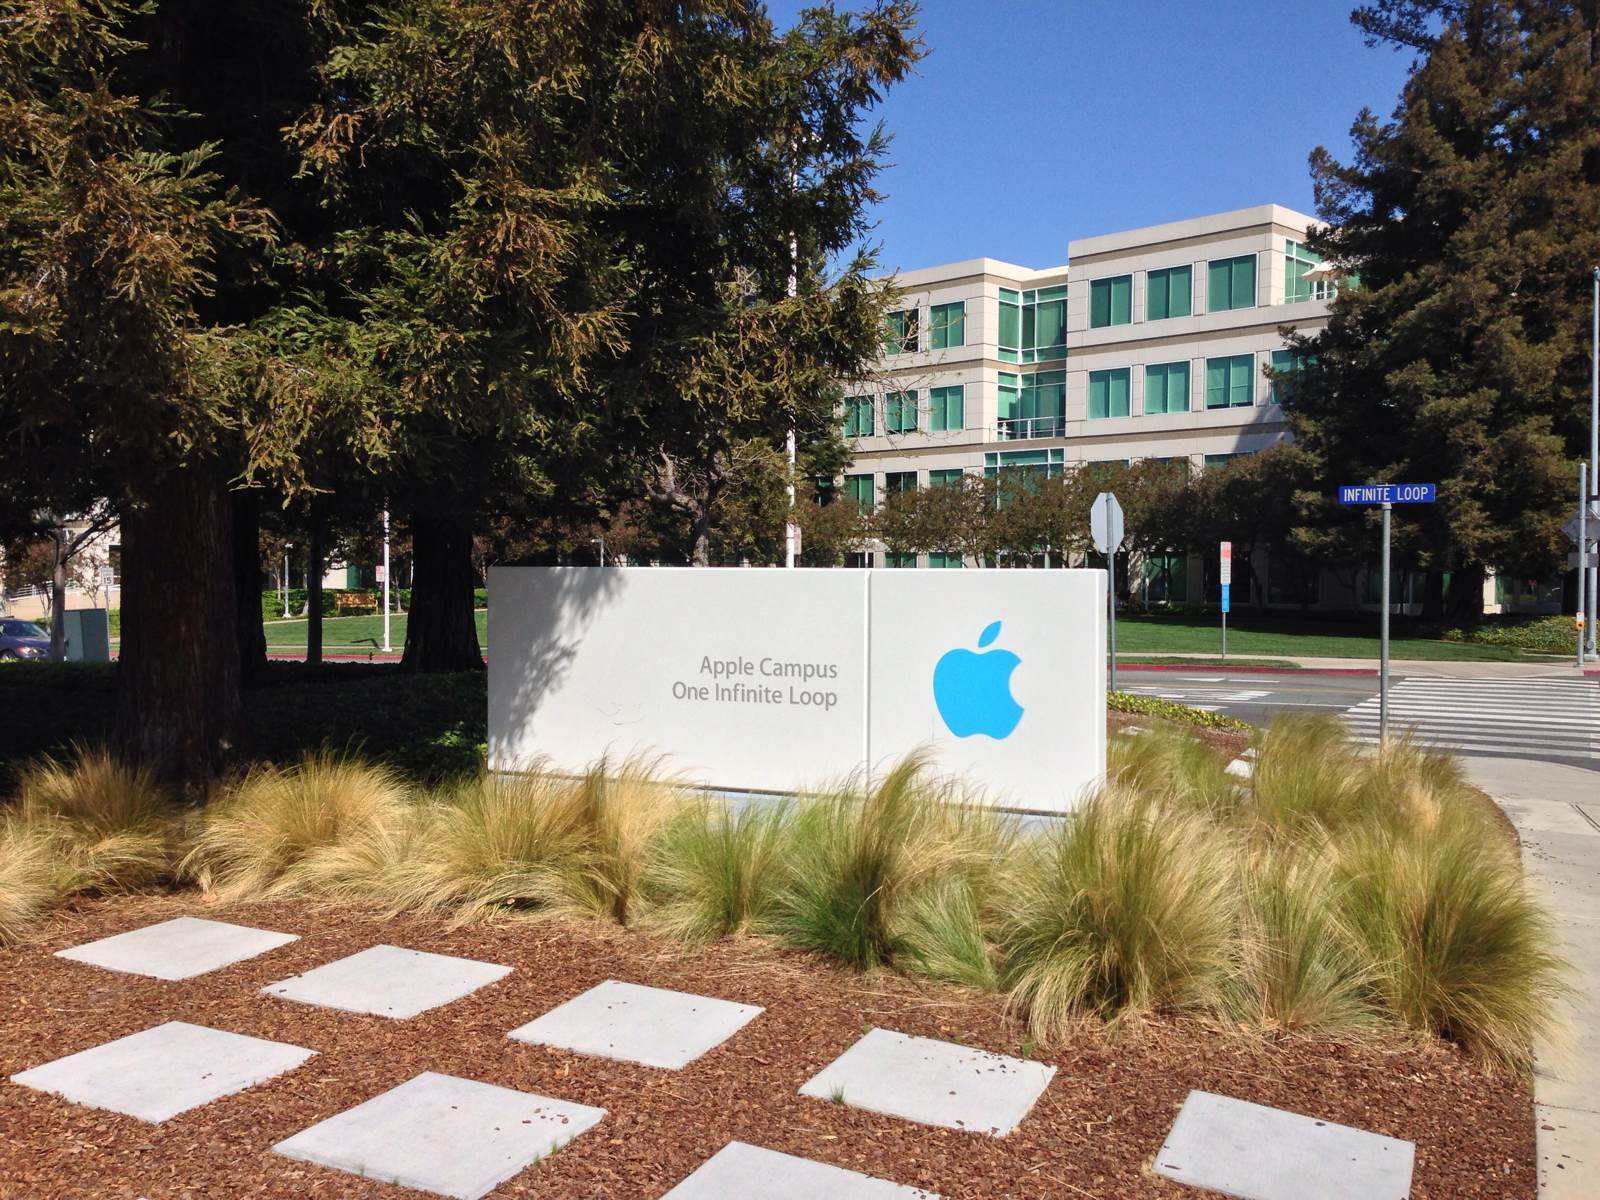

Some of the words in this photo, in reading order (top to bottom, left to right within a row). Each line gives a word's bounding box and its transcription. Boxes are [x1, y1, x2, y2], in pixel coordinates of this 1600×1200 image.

[1344, 488, 1390, 502] INFINITE
[1397, 487, 1429, 501] LOOP
[699, 655, 754, 679] Apple
[759, 657, 838, 682] Campus
[672, 681, 709, 701] One
[715, 683, 783, 704] Infinite
[789, 686, 838, 711] Loop
